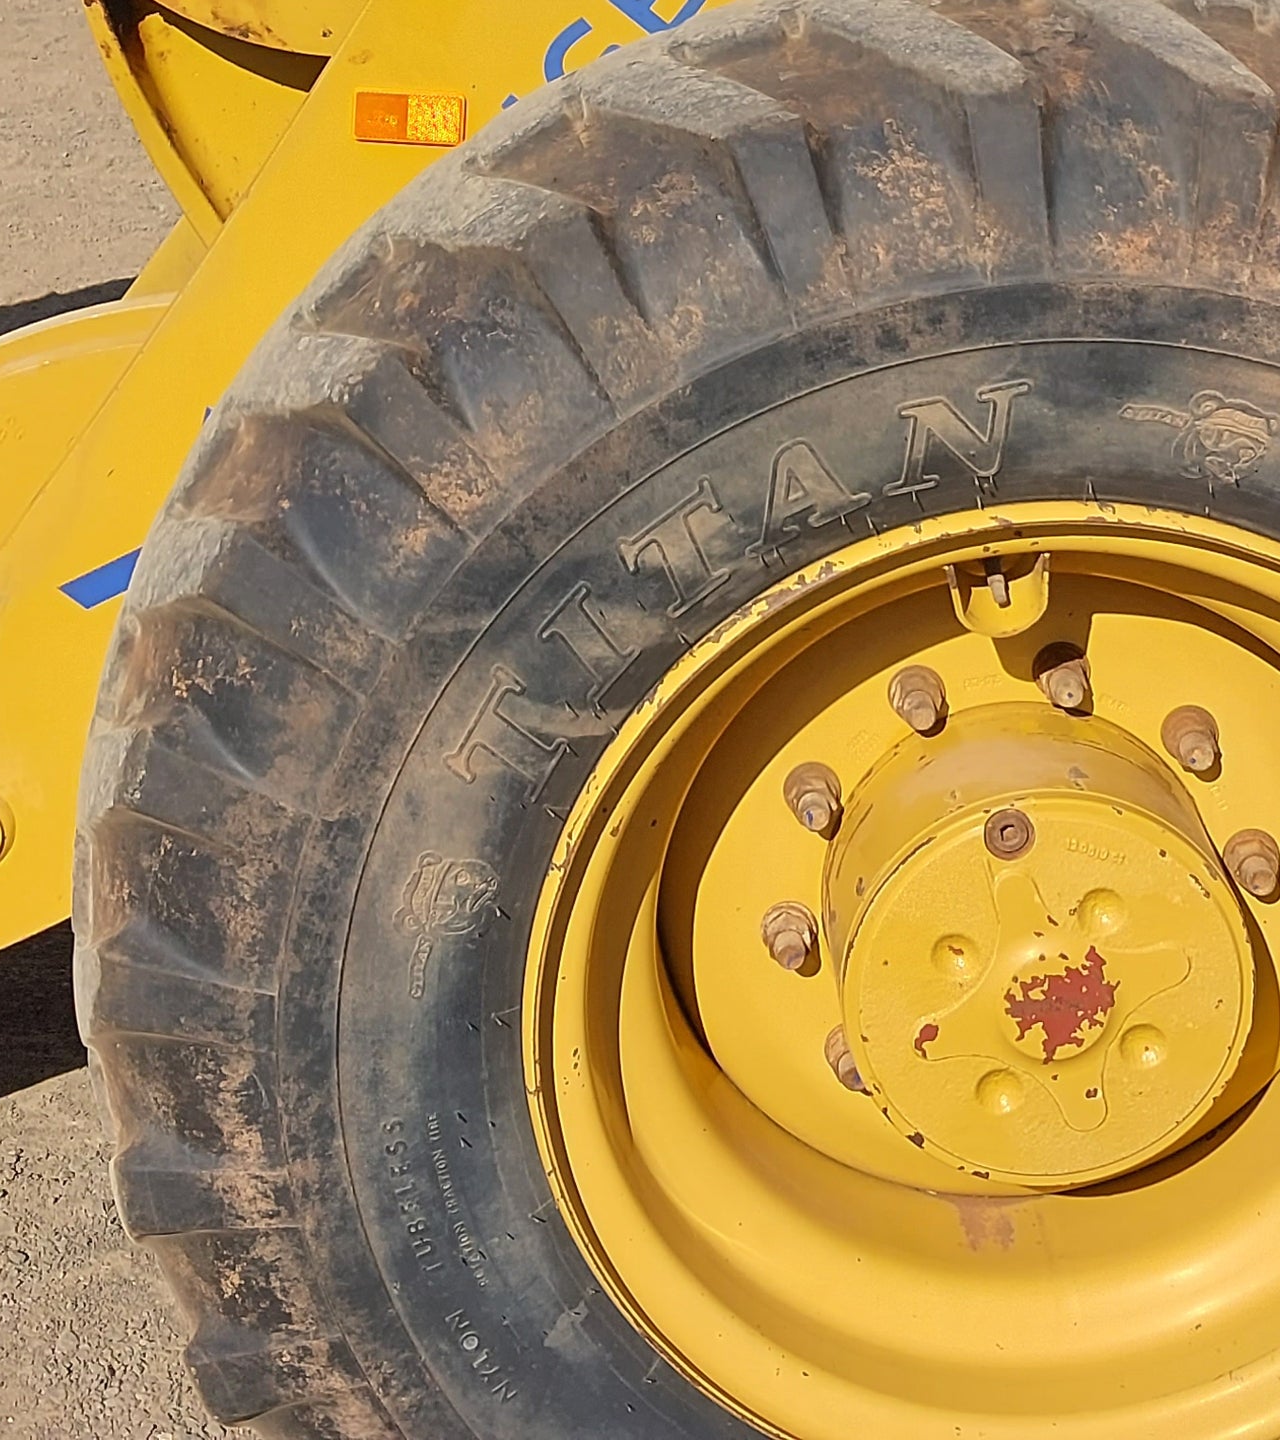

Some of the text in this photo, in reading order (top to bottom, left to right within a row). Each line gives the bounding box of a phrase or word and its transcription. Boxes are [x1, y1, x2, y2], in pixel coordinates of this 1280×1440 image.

[443, 380, 1033, 803] TITAN
[380, 1118, 518, 1405] NYLON TUBELESS
